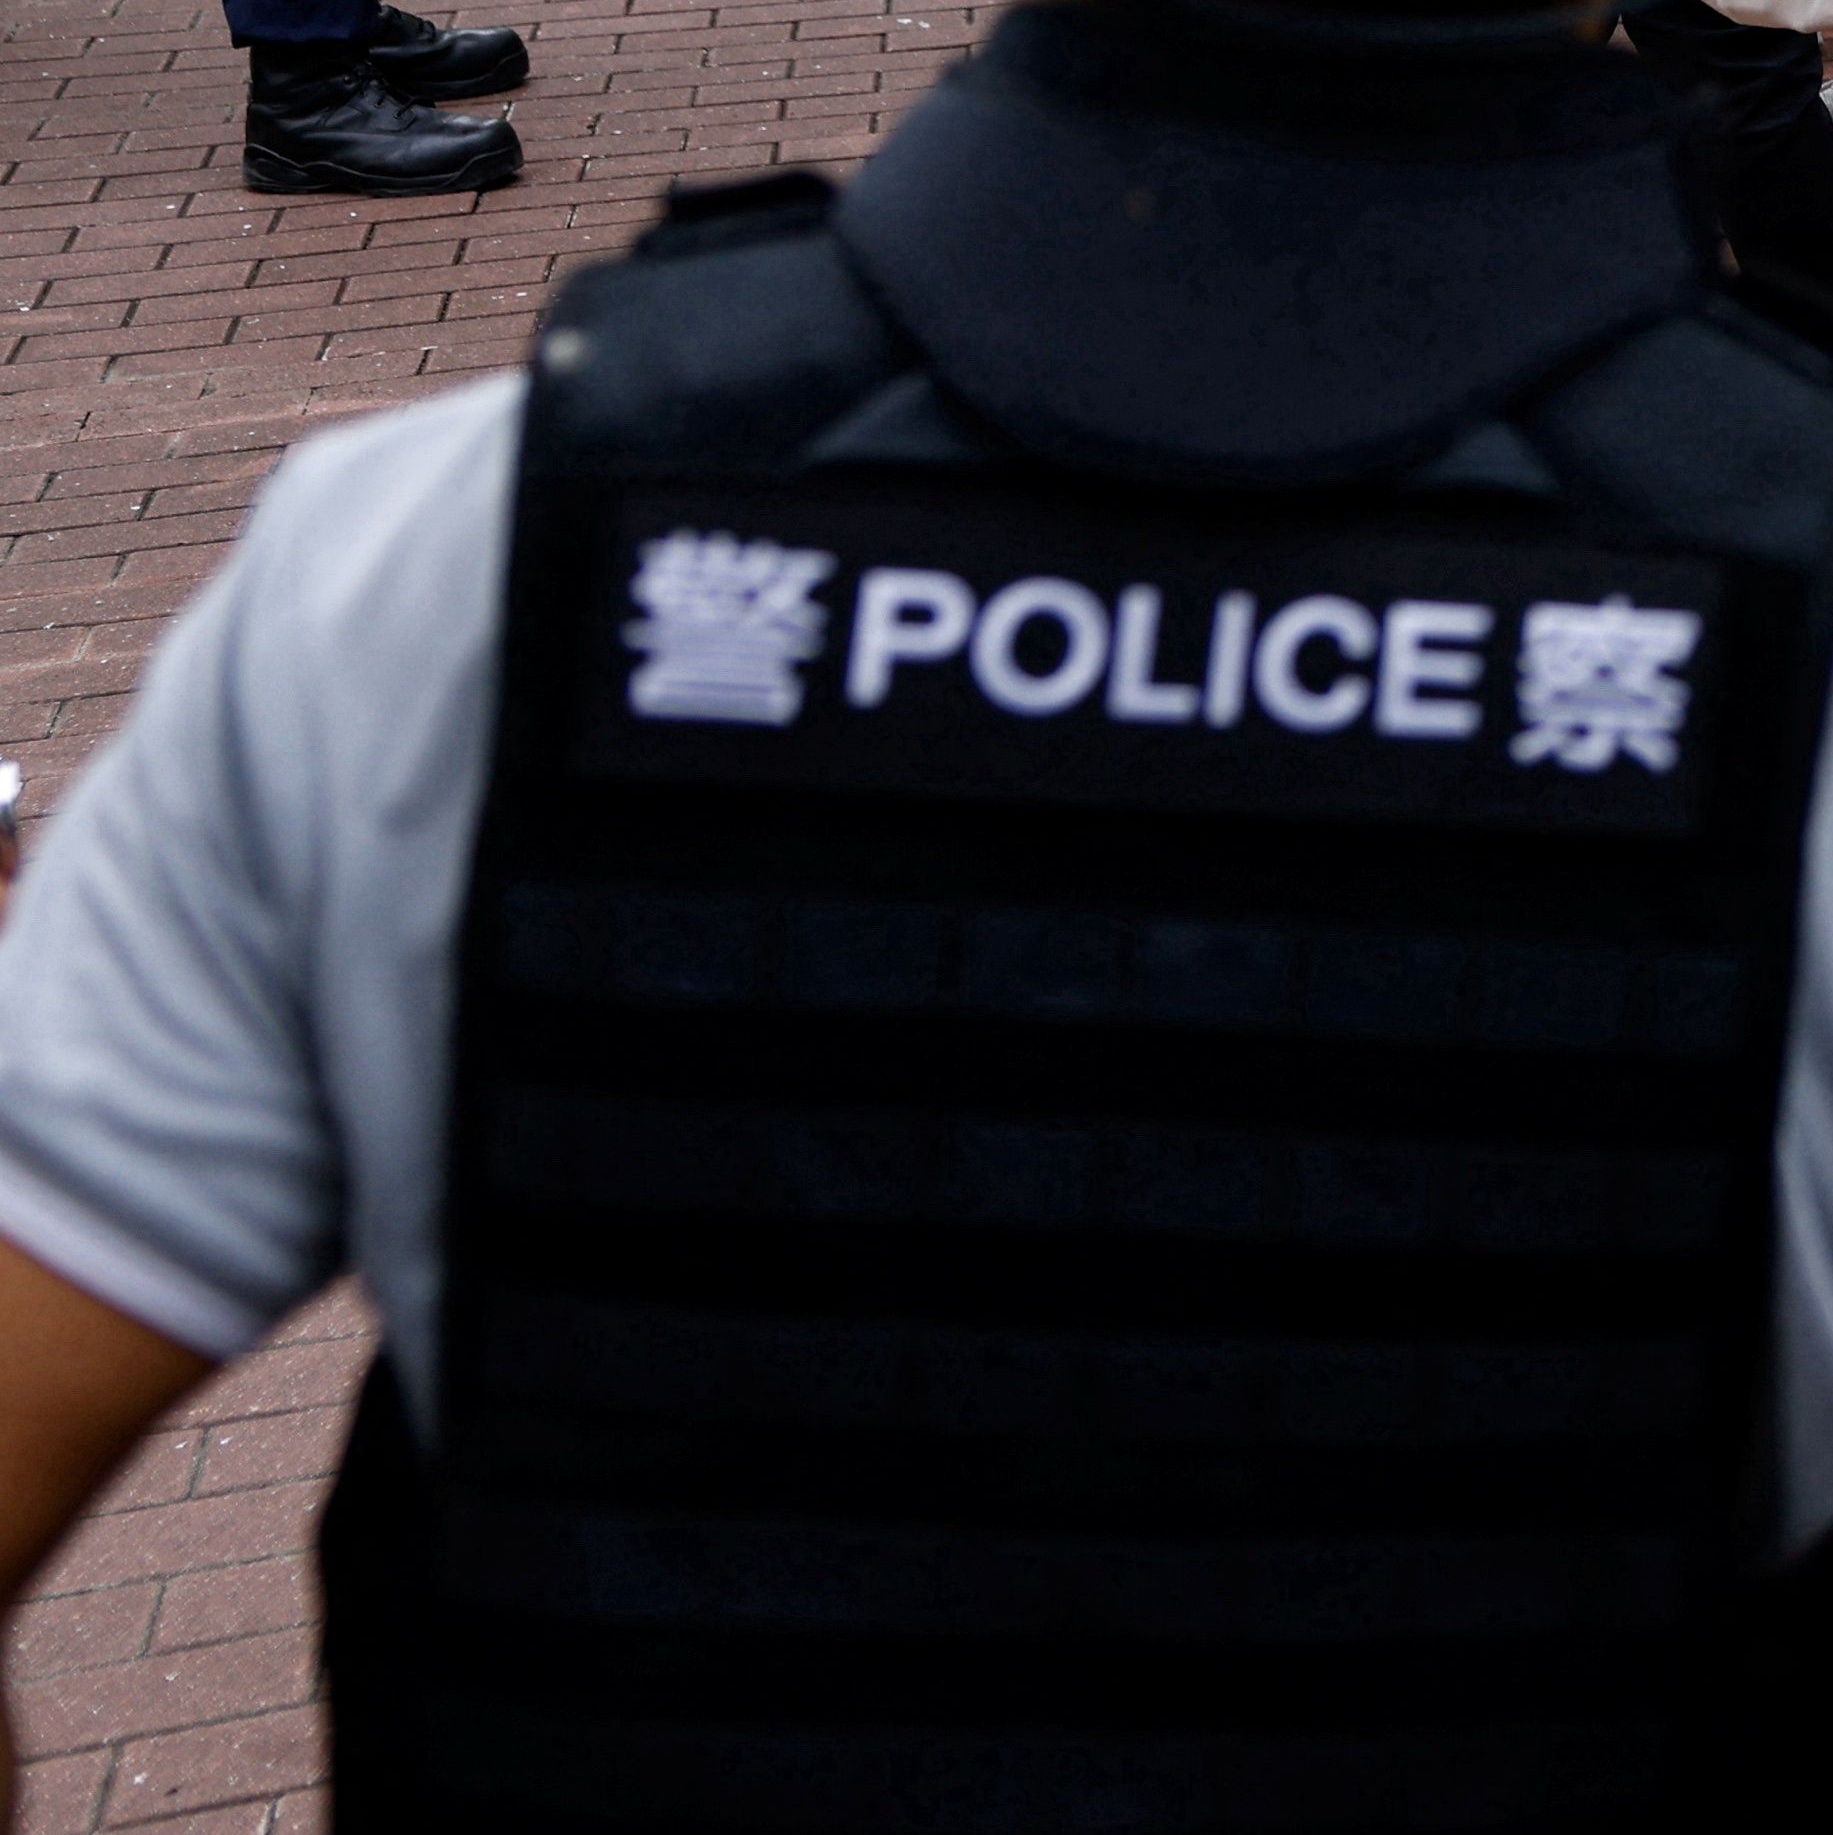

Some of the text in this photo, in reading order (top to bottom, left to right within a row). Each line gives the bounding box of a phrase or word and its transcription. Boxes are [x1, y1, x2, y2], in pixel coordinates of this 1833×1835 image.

[628, 531, 1699, 770] 警 POLICE 察
